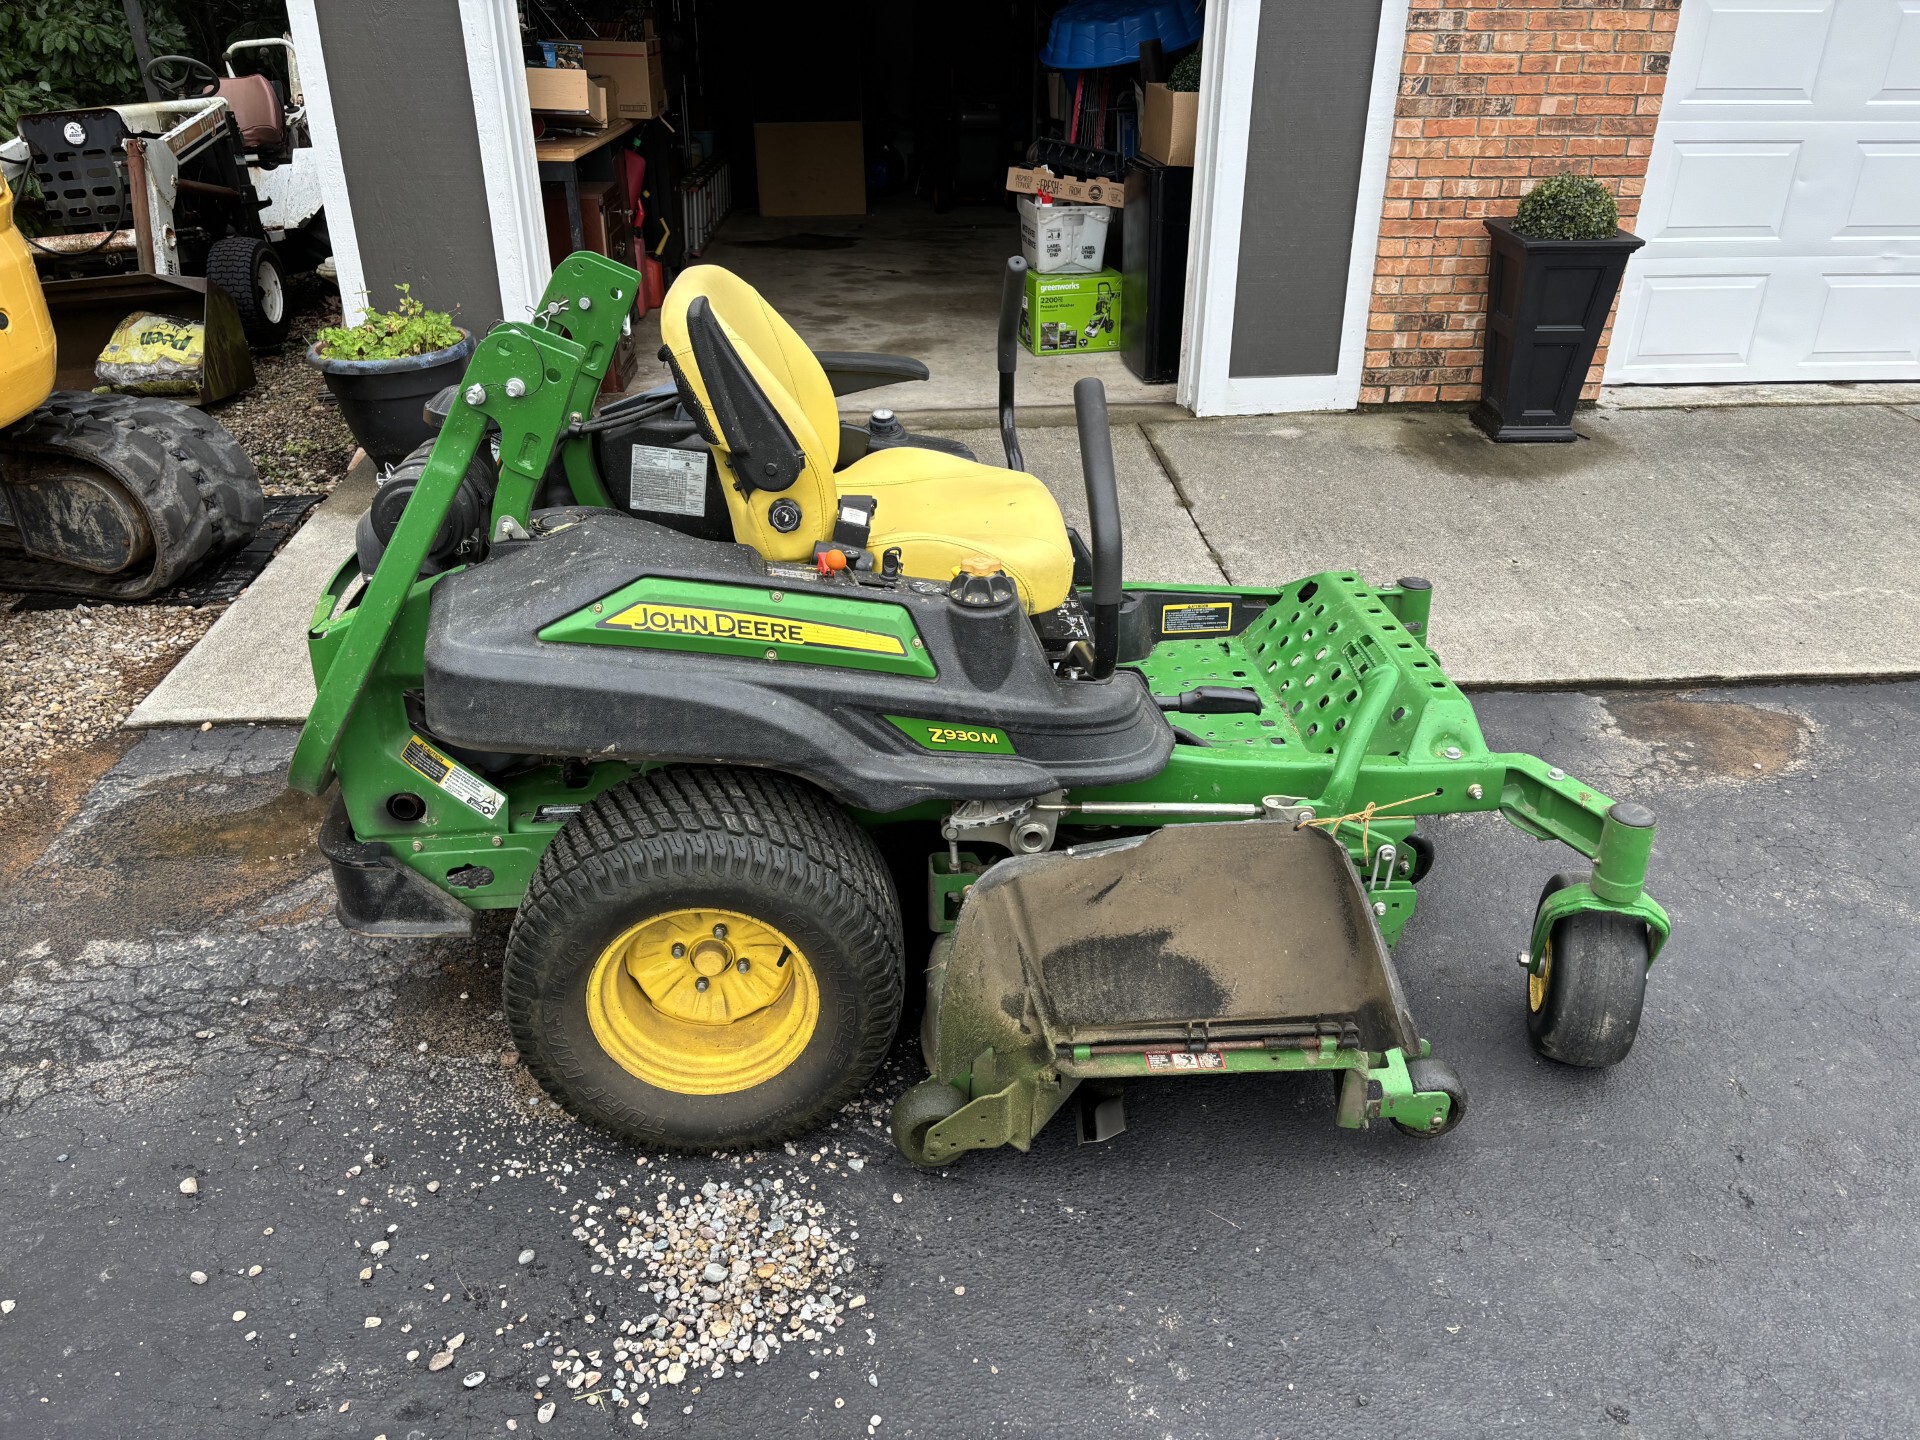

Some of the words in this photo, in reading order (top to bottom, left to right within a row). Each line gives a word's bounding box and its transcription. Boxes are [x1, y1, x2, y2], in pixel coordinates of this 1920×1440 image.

[1040, 179, 1059, 195] FRESH
[1068, 186, 1082, 196] FROM
[1040, 282, 1080, 293] greenworks
[1040, 296, 1058, 304] 2200
[634, 608, 708, 632] JOHN
[715, 613, 804, 642] DEERE
[423, 744, 445, 763] CAUTION
